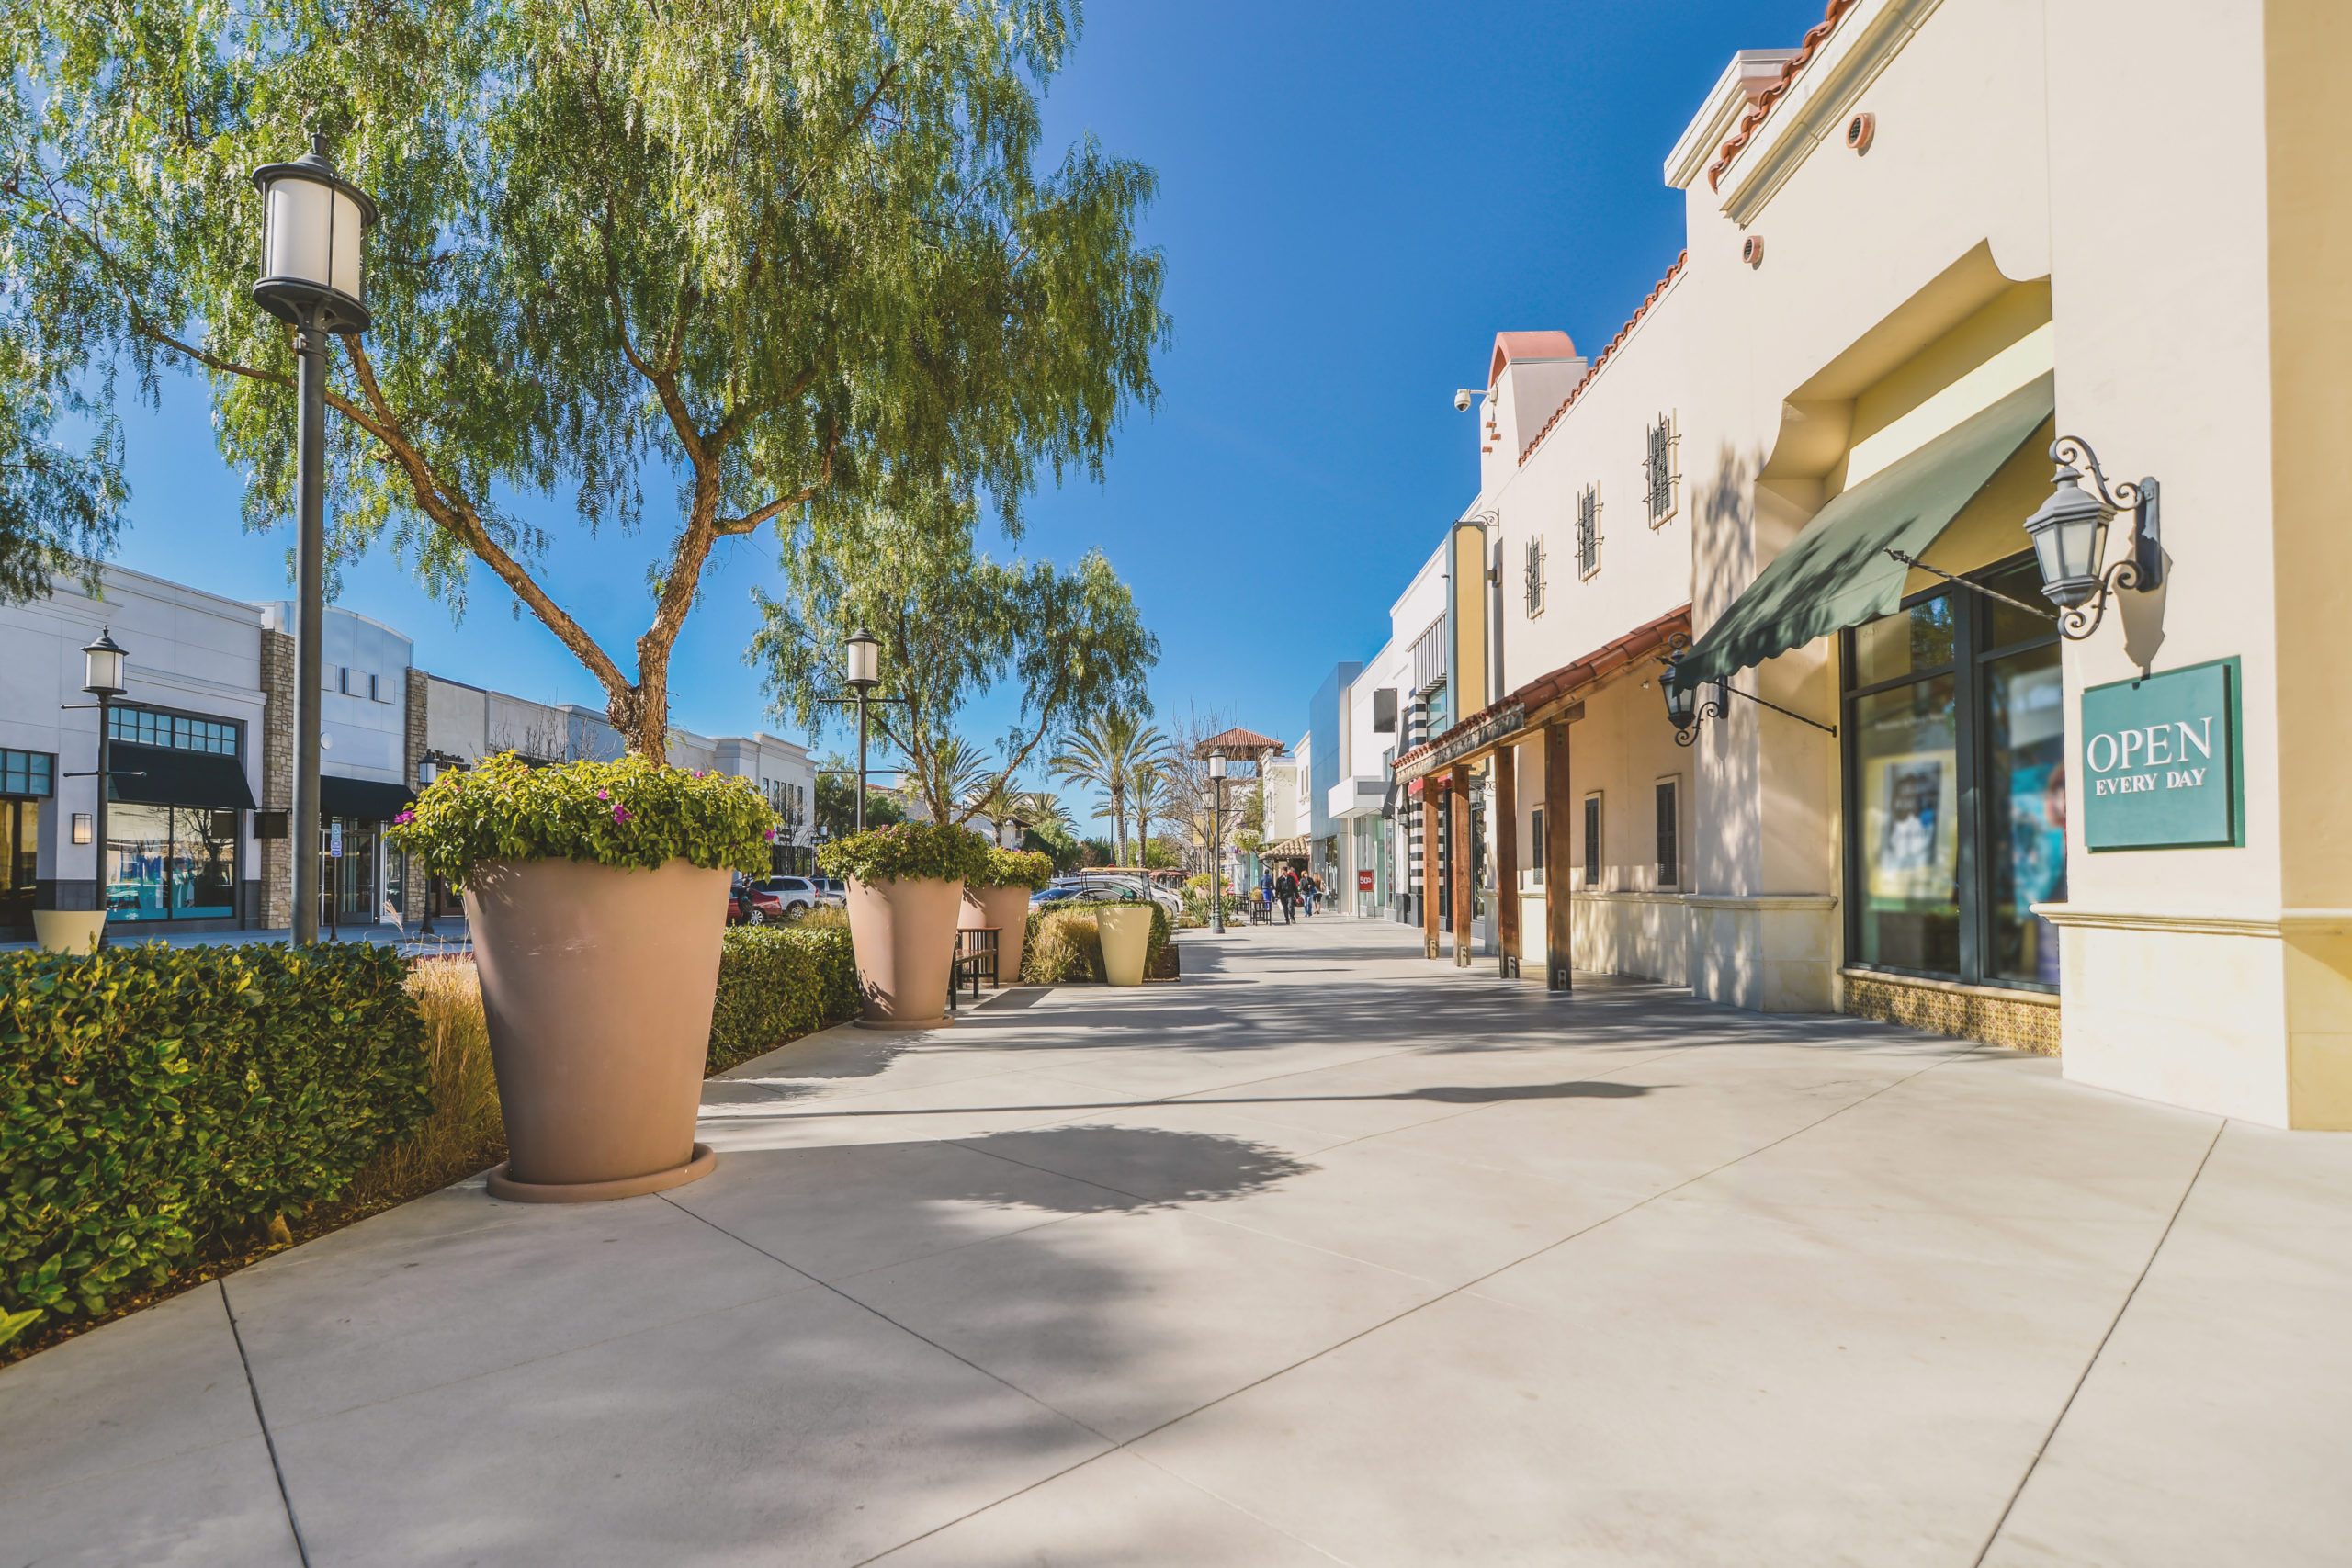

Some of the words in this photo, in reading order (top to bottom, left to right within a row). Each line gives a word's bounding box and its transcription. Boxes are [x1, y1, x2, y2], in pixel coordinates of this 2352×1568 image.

[2086, 716, 2213, 773] OPEN
[2095, 773, 2158, 796] EVERY
[2166, 768, 2207, 789] DAY
